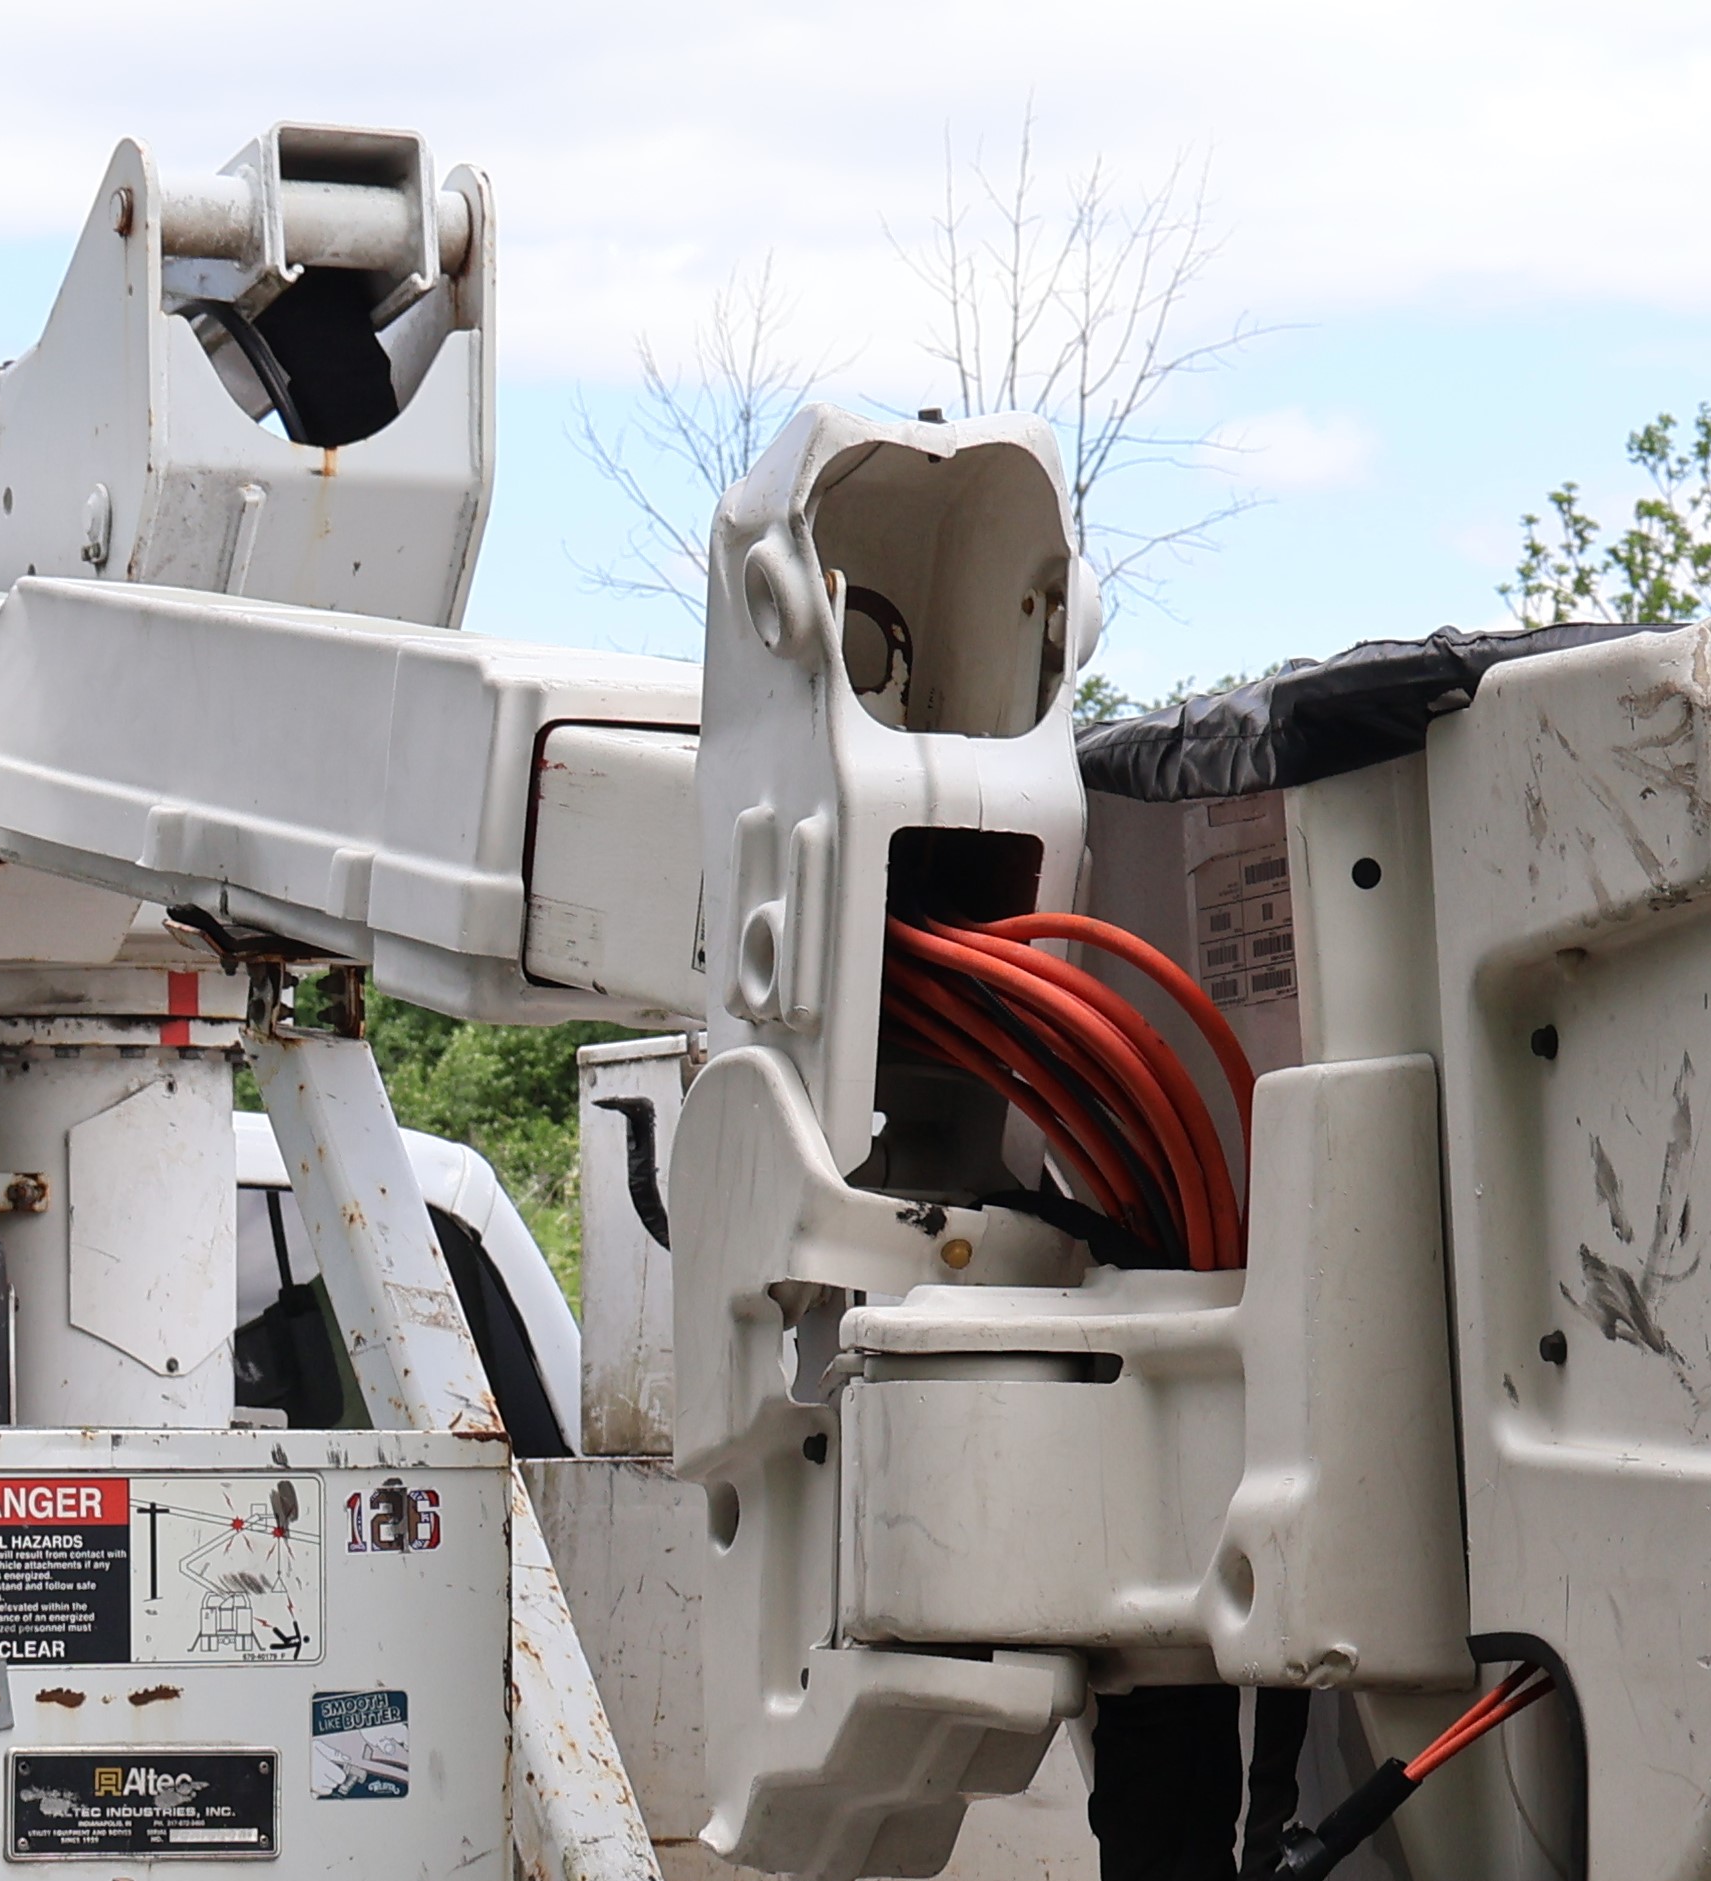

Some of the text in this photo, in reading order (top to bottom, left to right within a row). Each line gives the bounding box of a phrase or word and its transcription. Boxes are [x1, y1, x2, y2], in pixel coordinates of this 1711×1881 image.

[11, 1535, 83, 1549] HAZARDS
[16, 1550, 43, 1559] result
[45, 1550, 67, 1559] from
[69, 1550, 104, 1558] contact
[107, 1550, 126, 1558] with
[24, 1561, 82, 1569] attachments
[84, 1561, 91, 1569] if
[93, 1561, 110, 1571] any
[25, 1582, 43, 1590] and
[45, 1581, 74, 1590] follow
[76, 1581, 96, 1590] safe
[41, 1602, 69, 1611] within
[72, 1602, 87, 1611] the
[22, 1613, 32, 1622] of
[34, 1614, 46, 1622] an
[49, 1612, 95, 1623] energized
[18, 1624, 65, 1634] personnel
[68, 1624, 91, 1632] must
[321, 1693, 388, 1718] SMOOTH
[318, 1706, 401, 1732] LIKE BUTTER
[53, 1806, 236, 1819] ALTEC INDUSTRIES, INC.
